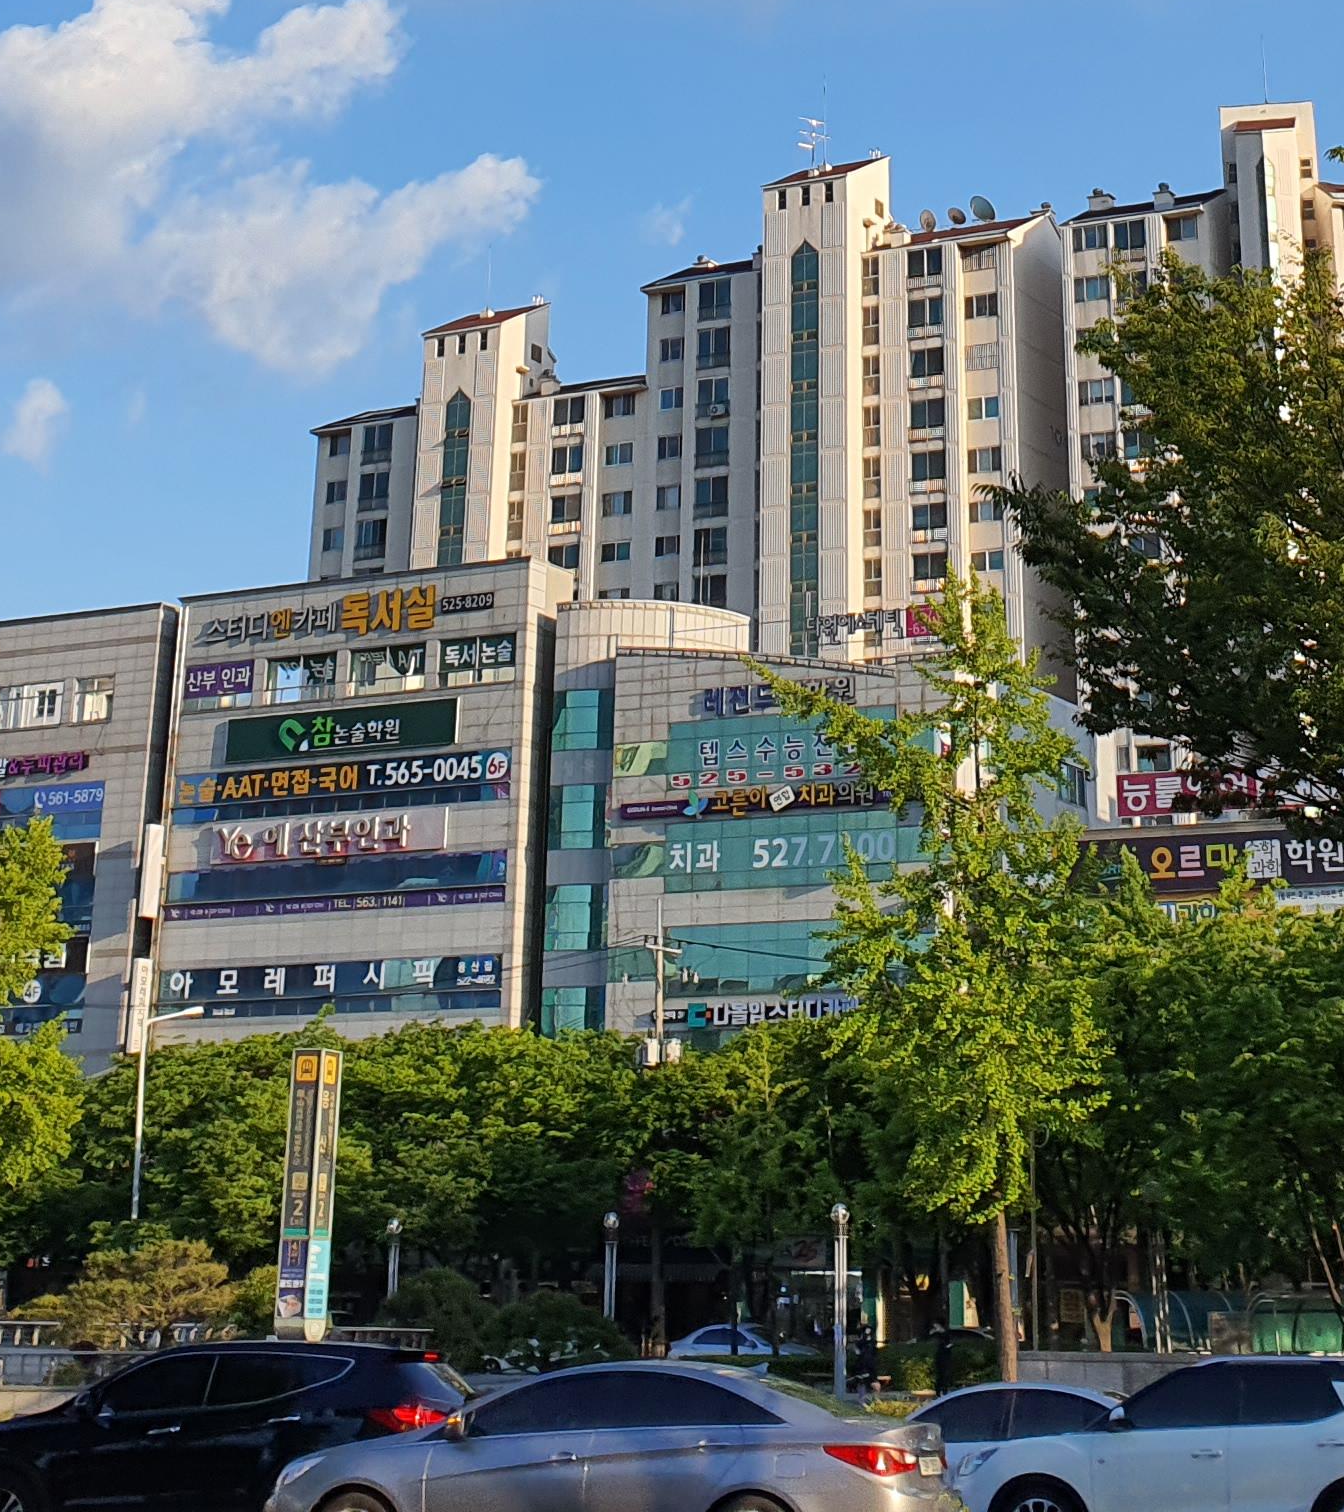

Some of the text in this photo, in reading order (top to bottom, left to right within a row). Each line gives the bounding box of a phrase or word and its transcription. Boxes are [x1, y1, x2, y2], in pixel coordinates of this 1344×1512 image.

[341, 585, 436, 636] 독서실
[444, 640, 513, 667] 독서 논술
[487, 757, 506, 775] 6F
[47, 787, 104, 806] 561-5879
[798, 781, 875, 808] 치과의원
[299, 814, 412, 854] 산부인과
[669, 832, 896, 874] 치과 527.700
[1284, 838, 1344, 874] 학원
[169, 959, 436, 1000] 아모레퍼시픽
[293, 1199, 304, 1216] 2
